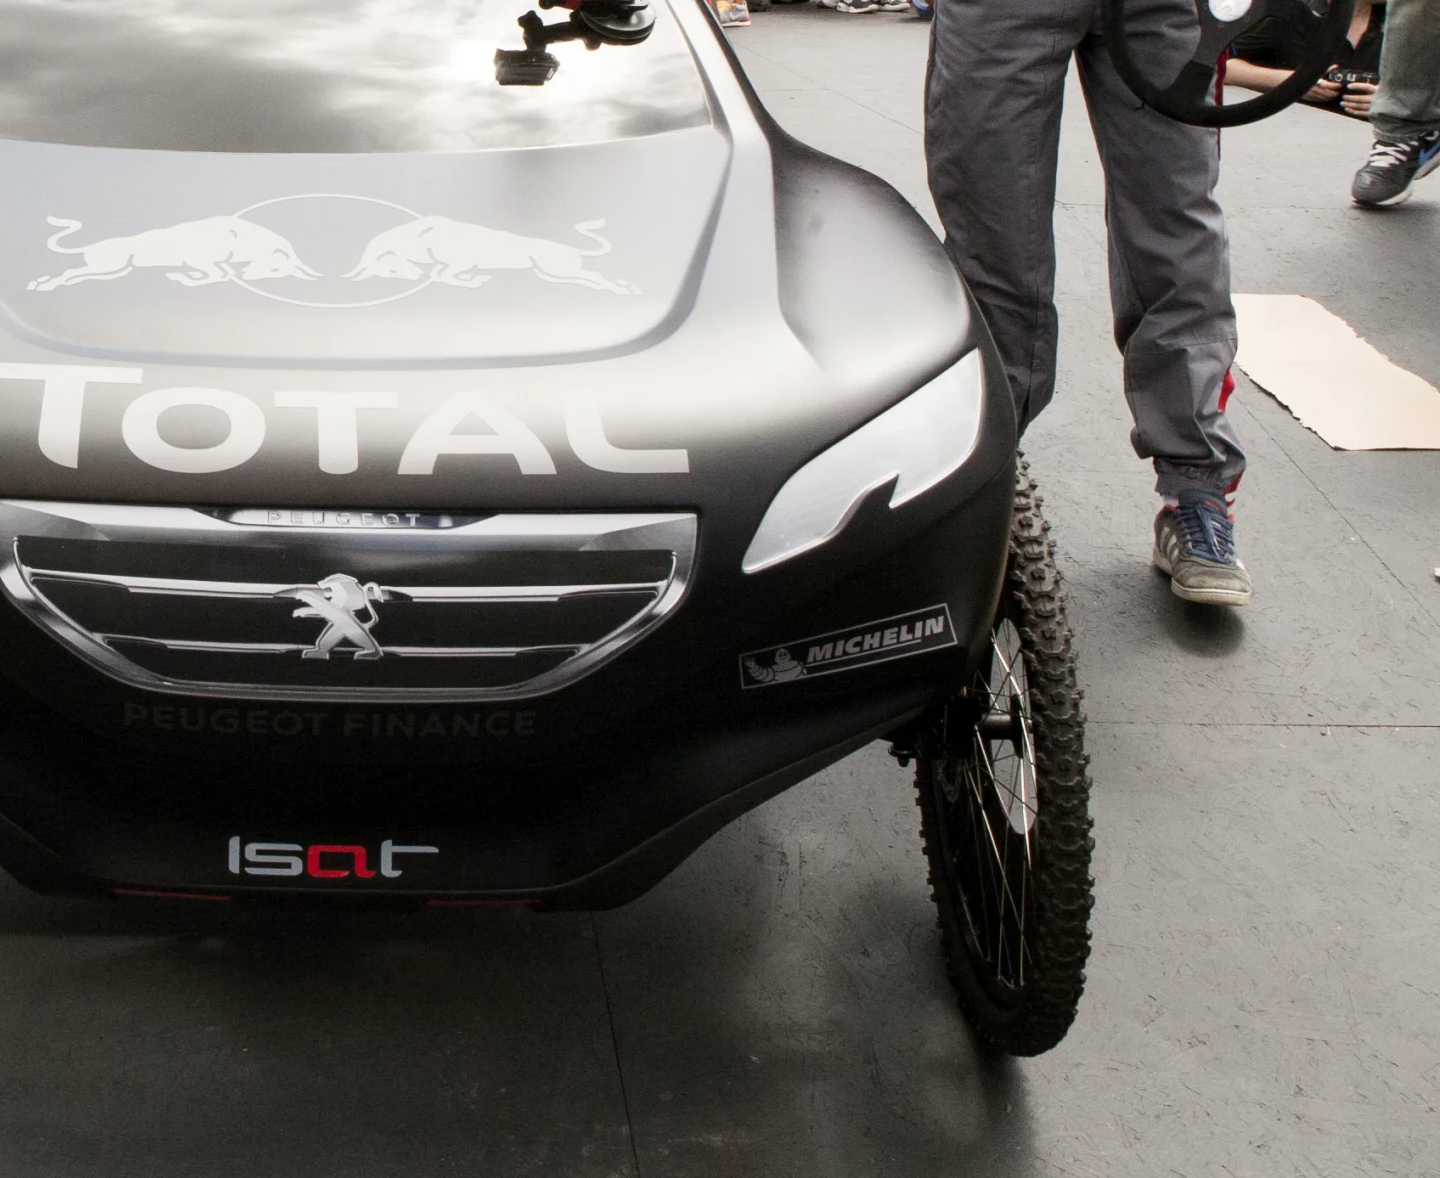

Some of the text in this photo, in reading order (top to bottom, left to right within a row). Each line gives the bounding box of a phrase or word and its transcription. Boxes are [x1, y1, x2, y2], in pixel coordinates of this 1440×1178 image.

[266, 510, 421, 528] PEUGEOT
[806, 615, 945, 663] MICHELIN
[122, 702, 538, 738] PEUGEOT FINANCE
